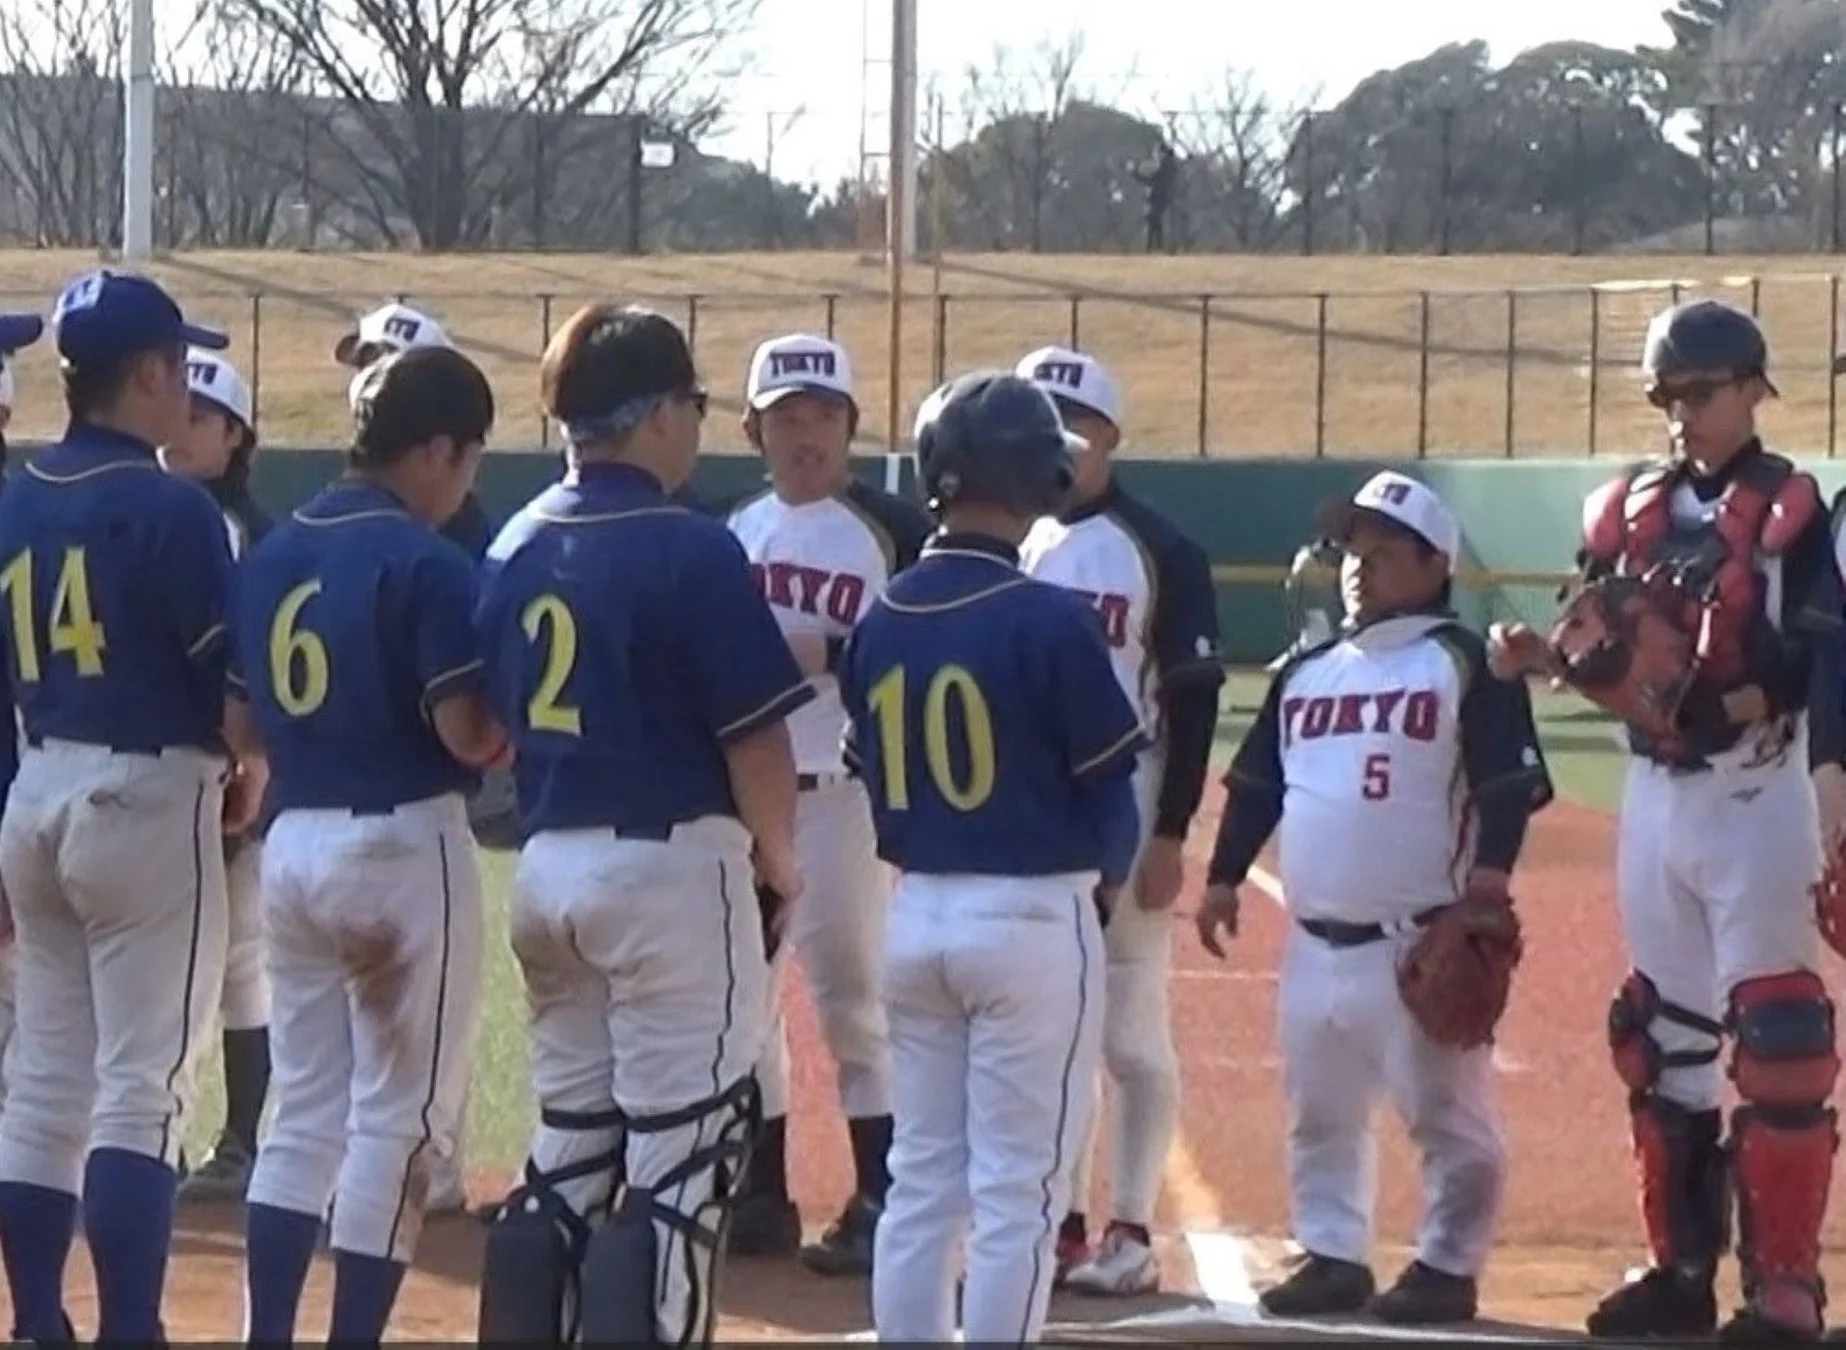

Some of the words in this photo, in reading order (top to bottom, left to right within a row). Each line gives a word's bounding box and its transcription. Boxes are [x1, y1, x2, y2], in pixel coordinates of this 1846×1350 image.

[0, 545, 107, 682] 14
[269, 576, 329, 717] 6
[521, 593, 582, 738] 2
[867, 662, 996, 811] 10
[1283, 687, 1441, 749] TOKYO
[1362, 752, 1391, 801] 5
